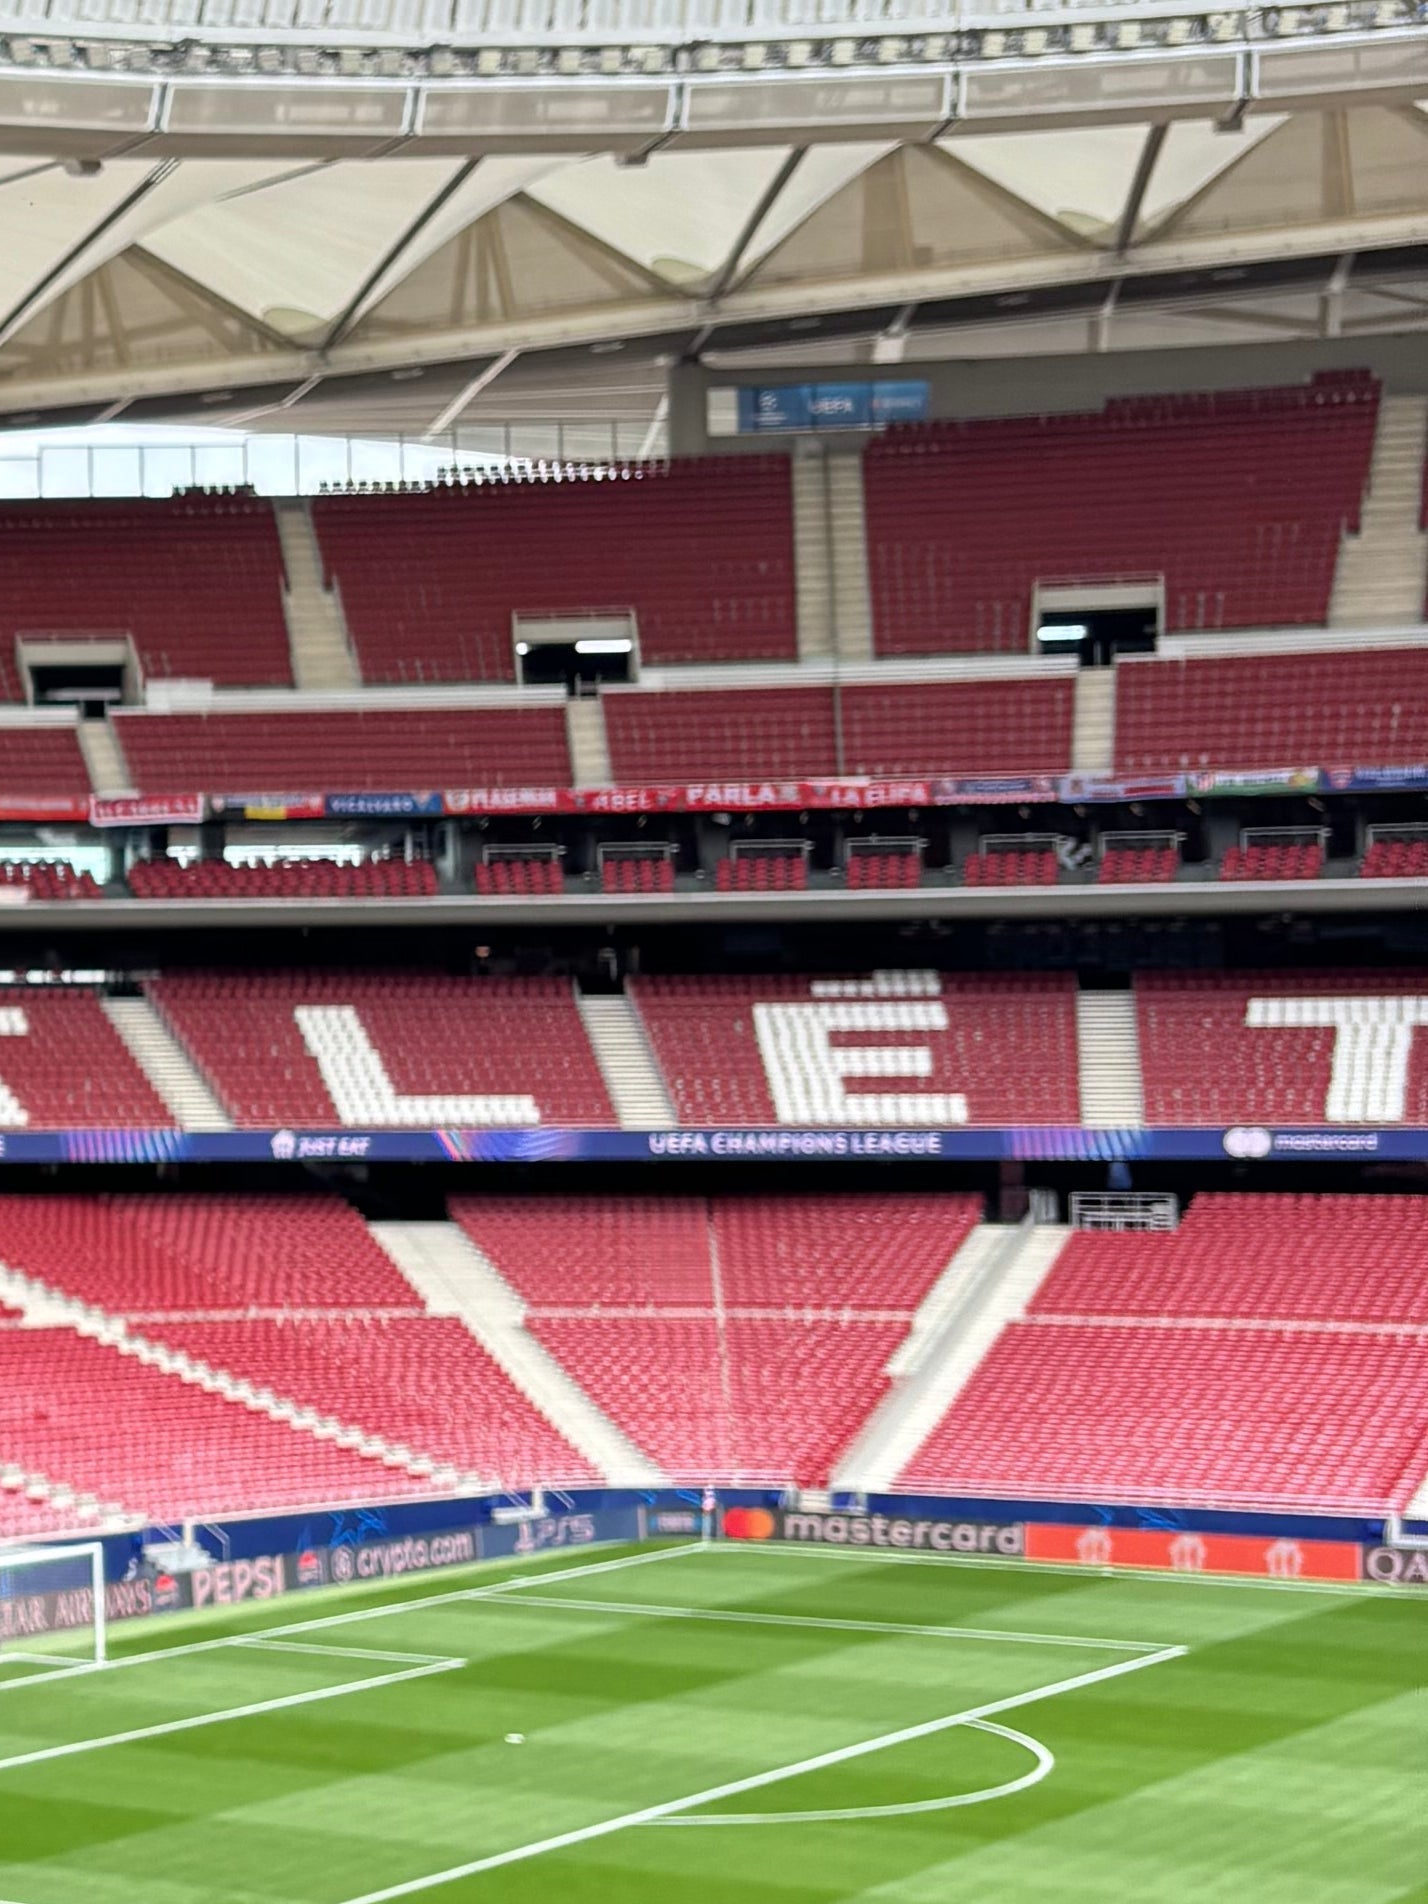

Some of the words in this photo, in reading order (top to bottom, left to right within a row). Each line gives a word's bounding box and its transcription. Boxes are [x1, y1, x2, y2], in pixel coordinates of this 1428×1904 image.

[648, 1132, 708, 1155] UEFA
[710, 1132, 849, 1155] CHAMPIONS
[850, 1132, 942, 1154] LEAGUE
[1275, 1132, 1378, 1151] mastercard
[355, 1530, 474, 1579] crypto.com
[783, 1512, 1024, 1555] mastercard
[193, 1553, 287, 1609] PEPSI
